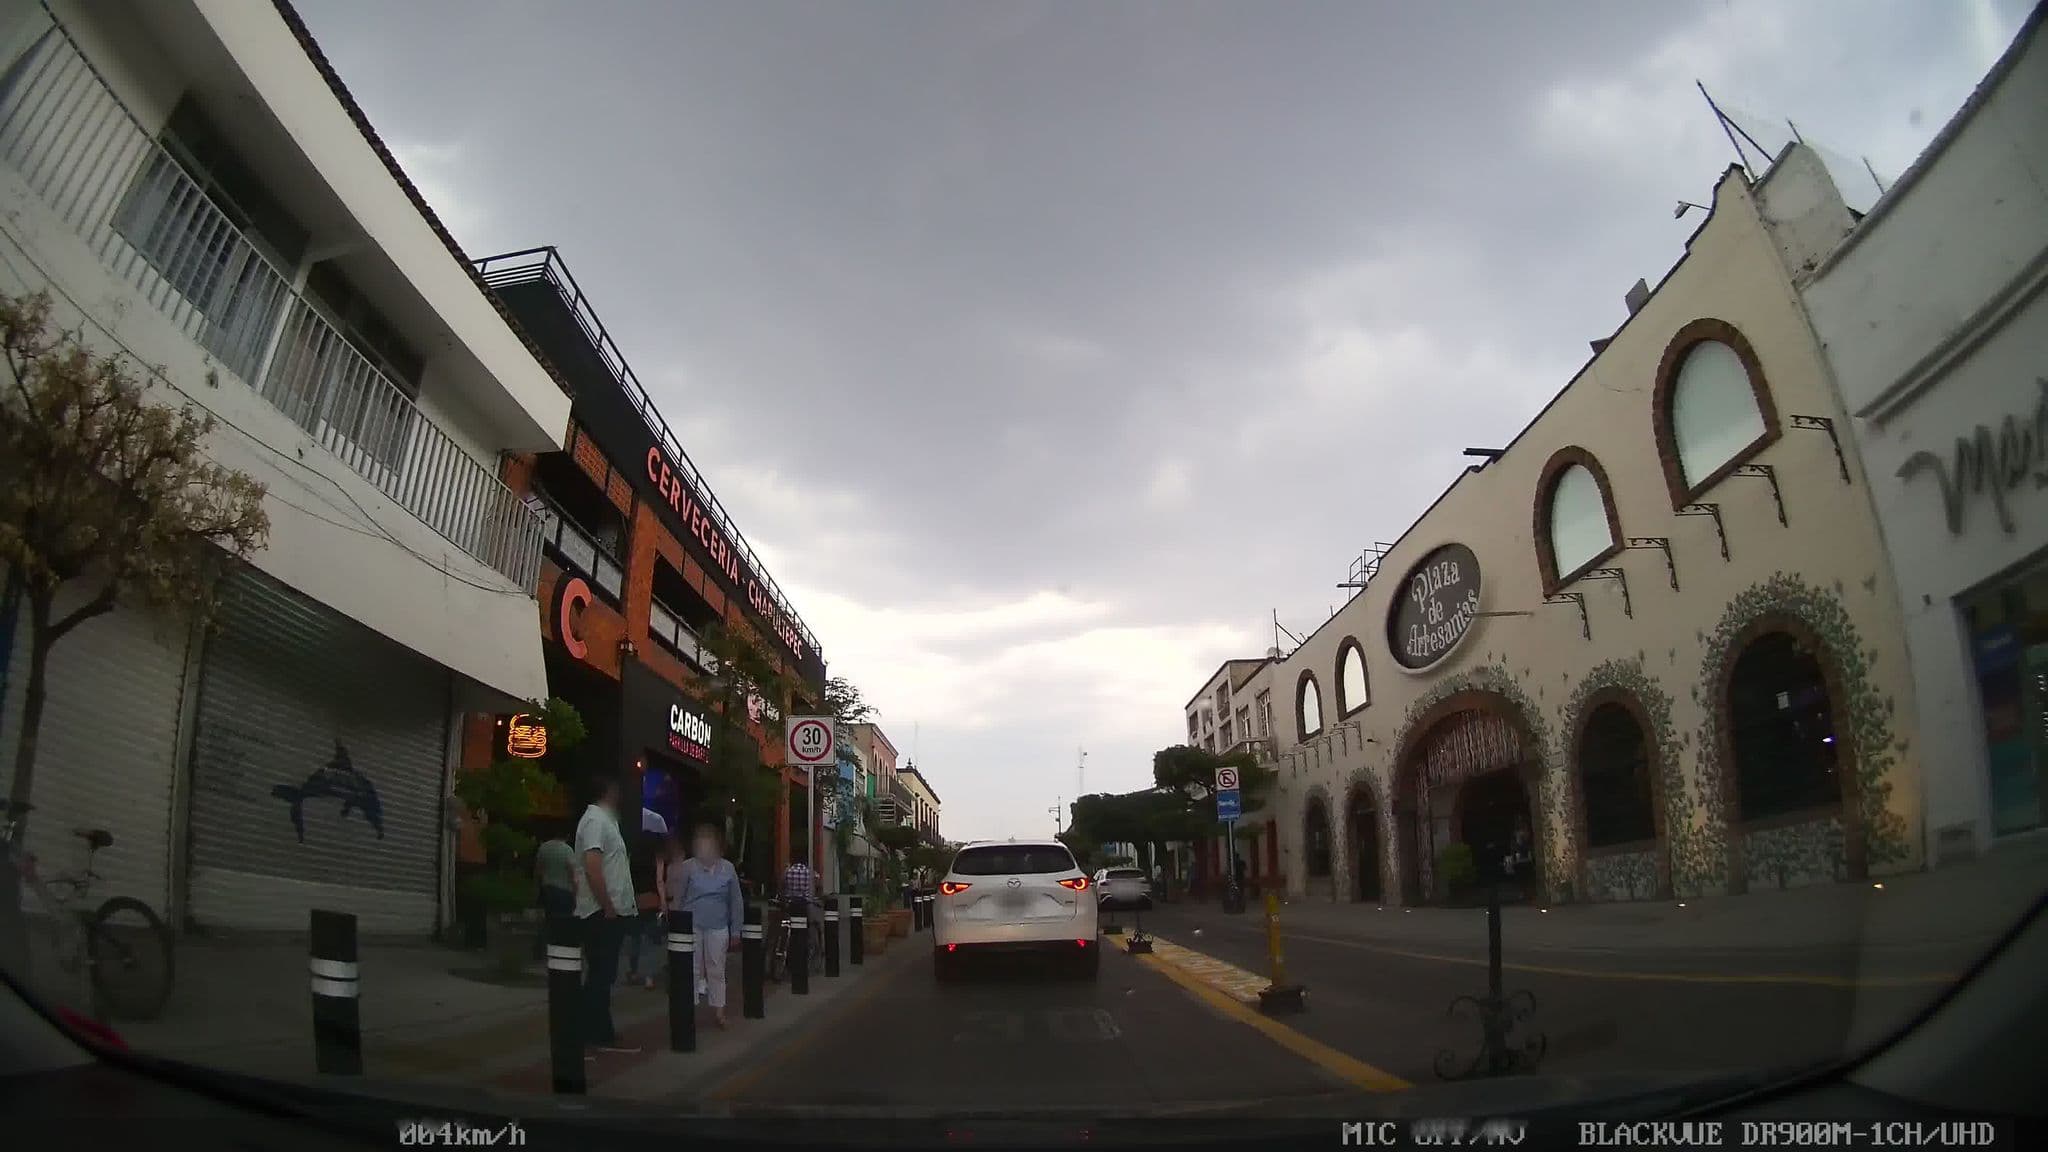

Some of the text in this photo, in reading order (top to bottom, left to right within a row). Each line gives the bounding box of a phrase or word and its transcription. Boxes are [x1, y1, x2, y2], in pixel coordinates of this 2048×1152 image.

[647, 446, 803, 660] CERVECERIA CHAPULTEPEC
[1412, 561, 1460, 614] Plaza
[1428, 597, 1444, 625] de
[560, 577, 593, 659] C
[802, 727, 821, 746] 30
